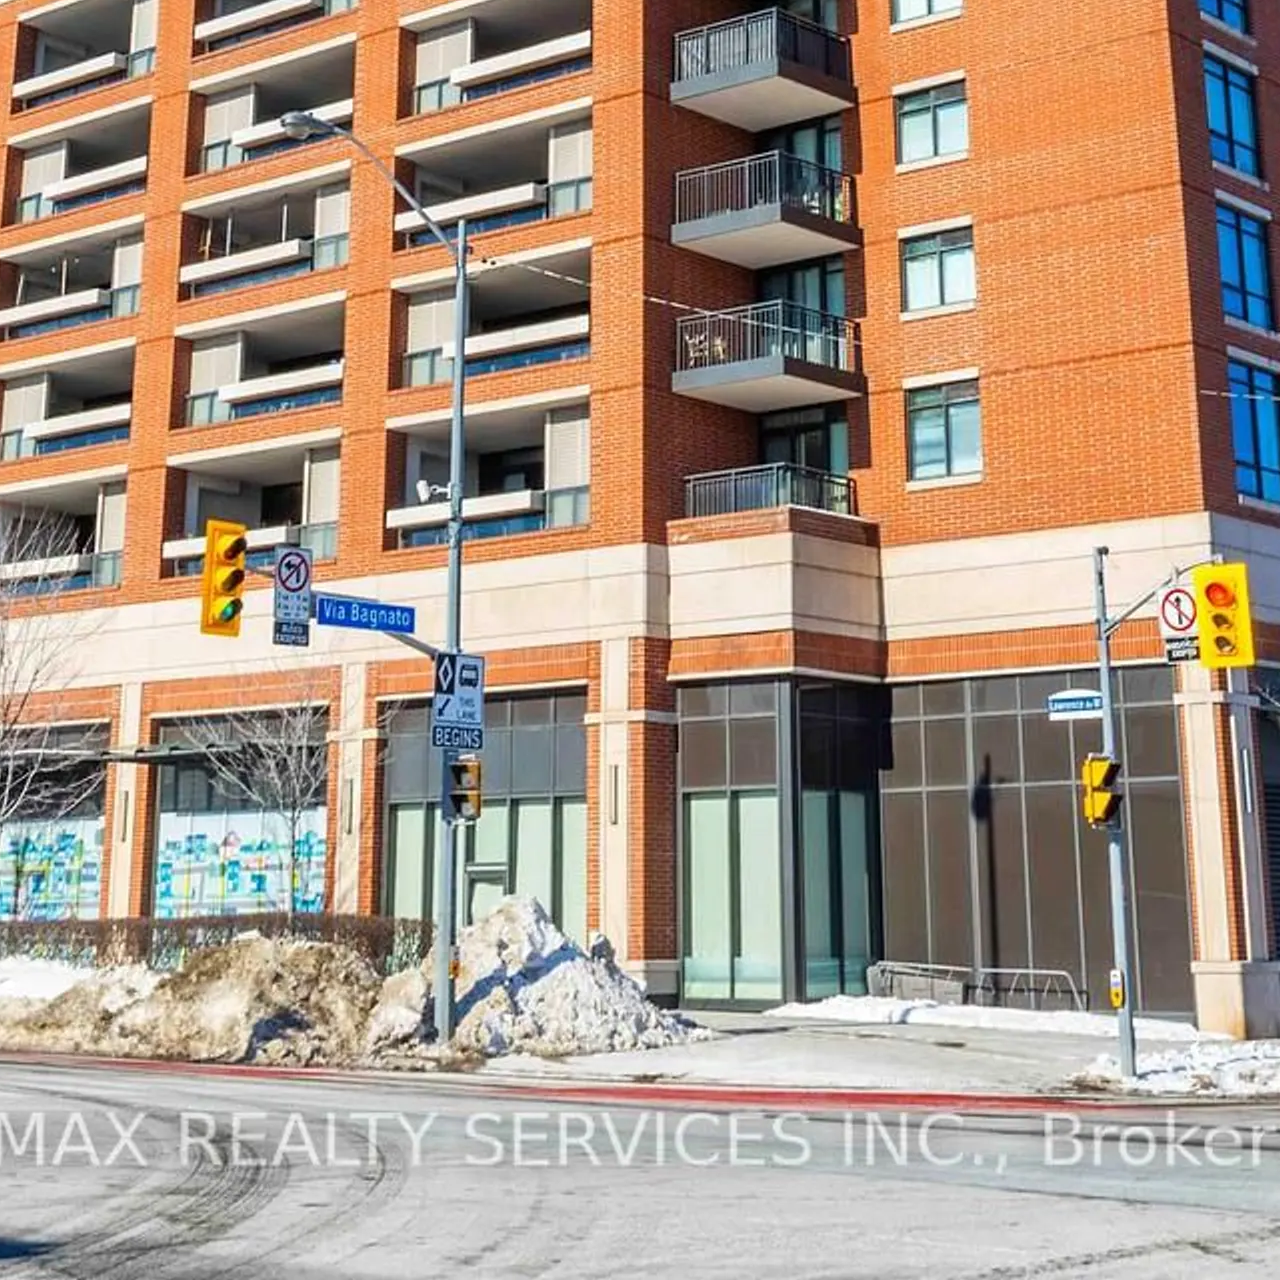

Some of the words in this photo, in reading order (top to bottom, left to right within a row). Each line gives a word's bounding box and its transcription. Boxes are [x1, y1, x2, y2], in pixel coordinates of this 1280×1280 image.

[324, 600, 345, 619] Via
[351, 603, 410, 627] Bagnato
[435, 728, 480, 748] BEGINS
